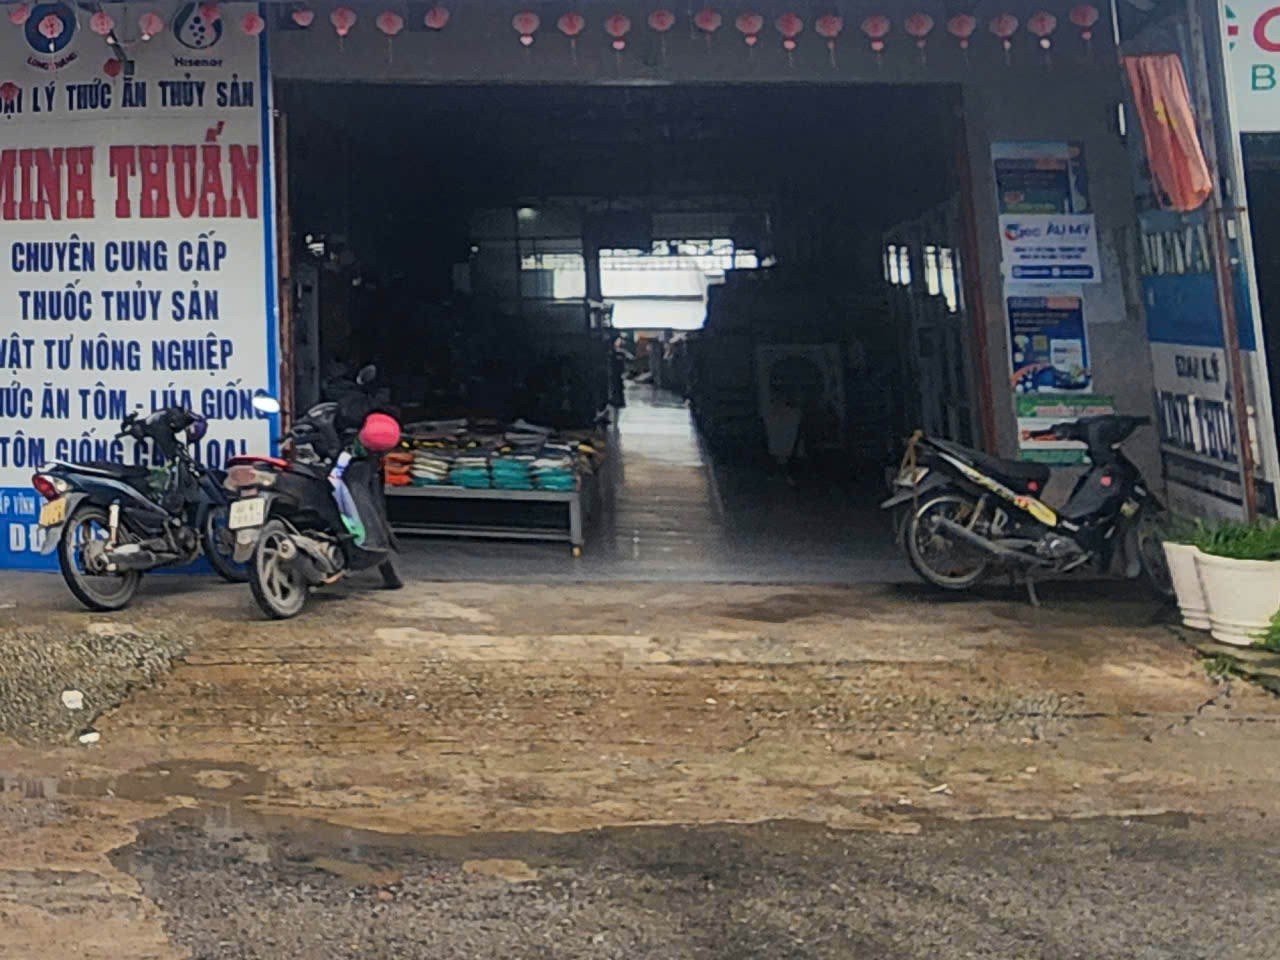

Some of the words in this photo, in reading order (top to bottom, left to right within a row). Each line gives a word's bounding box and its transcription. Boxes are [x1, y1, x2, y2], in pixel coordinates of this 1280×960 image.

[32, 81, 55, 113] LÝ
[66, 78, 112, 110] THỨC
[159, 73, 206, 107] THỦY
[216, 73, 254, 107] SẢN
[109, 120, 258, 219] THUẤN
[11, 233, 95, 273] CHUYÊN
[104, 240, 168, 272] CUNG
[178, 230, 227, 272] CẤP
[19, 279, 92, 321] THUỐC
[101, 280, 162, 321] THỦY
[171, 280, 219, 322] SẢN
[44, 334, 74, 370] TƯ
[80, 332, 141, 371] NÔNG
[152, 331, 234, 376] NGHIỆP
[40, 382, 70, 418] ĂN
[78, 381, 127, 420] TÔM
